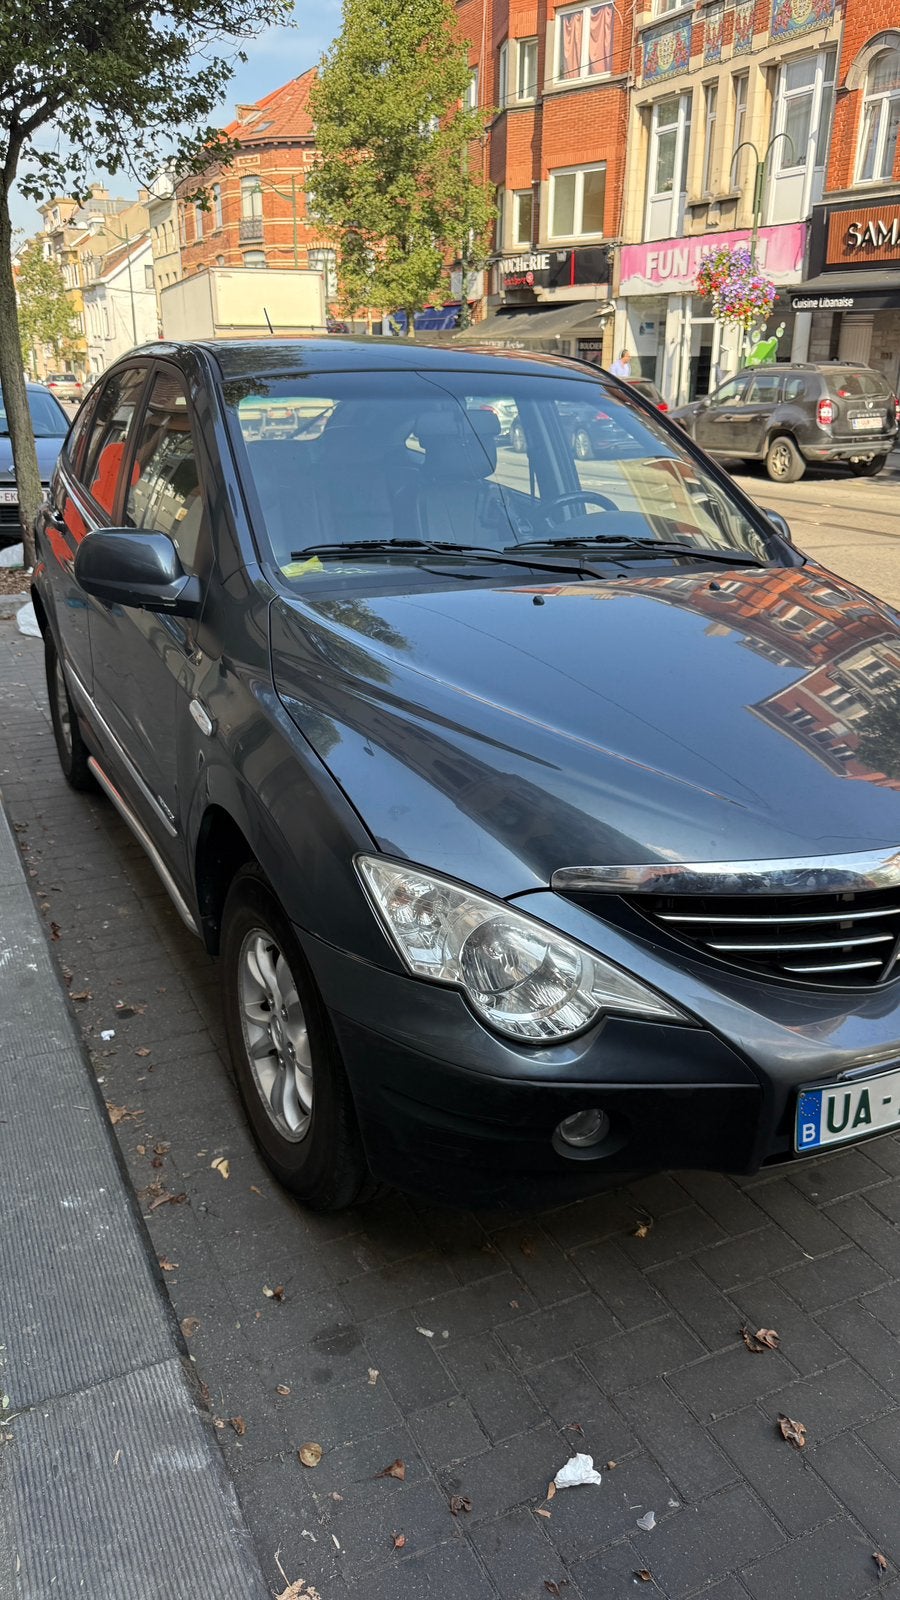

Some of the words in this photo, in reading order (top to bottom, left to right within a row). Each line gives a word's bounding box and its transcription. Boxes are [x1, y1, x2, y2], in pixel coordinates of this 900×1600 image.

[645, 247, 690, 279] FUN
[792, 297, 818, 309] Cuisine
[819, 297, 854, 308] Libanaise
[827, 1087, 900, 1134] UA-
[802, 1122, 816, 1143] B
